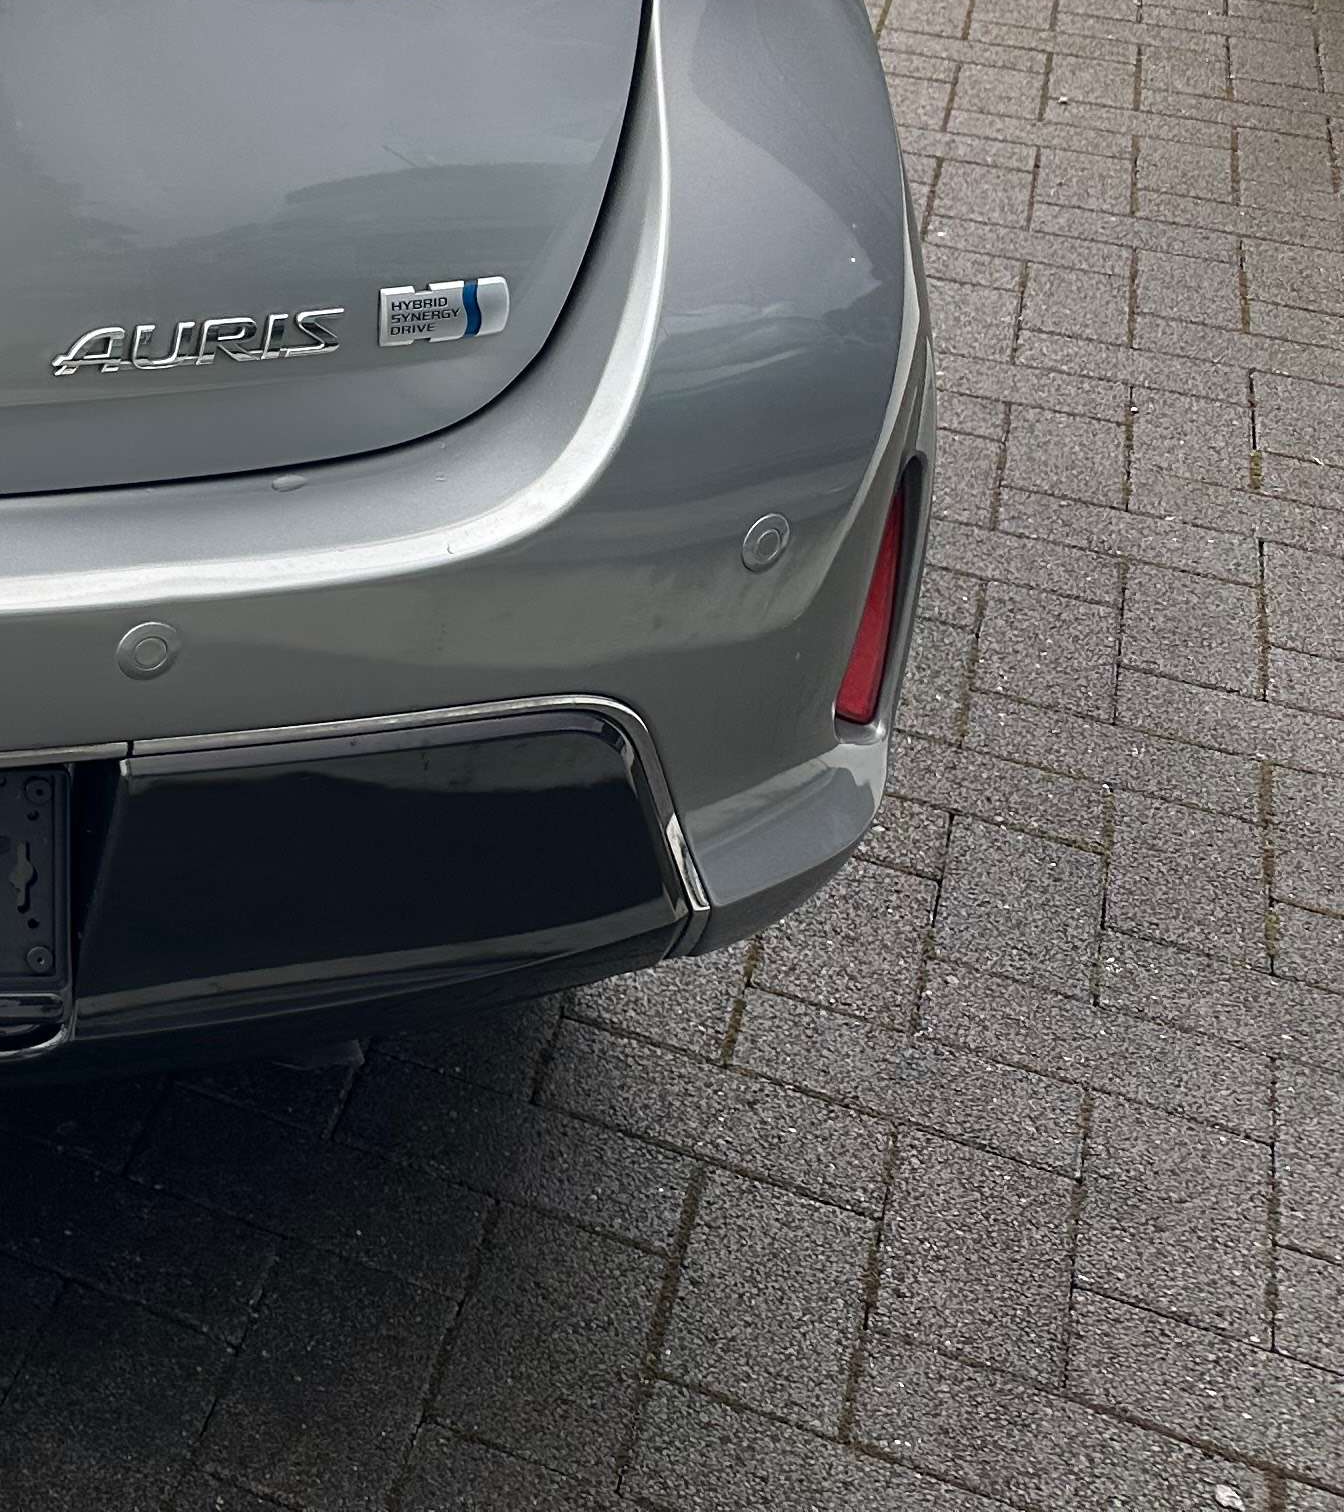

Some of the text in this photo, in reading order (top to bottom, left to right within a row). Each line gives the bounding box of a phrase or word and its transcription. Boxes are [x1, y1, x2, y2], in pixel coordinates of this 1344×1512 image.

[390, 295, 449, 312] HYBRID
[390, 307, 462, 324] SYNERGY
[390, 321, 435, 336] DRIVE
[51, 307, 345, 376] AURIS
